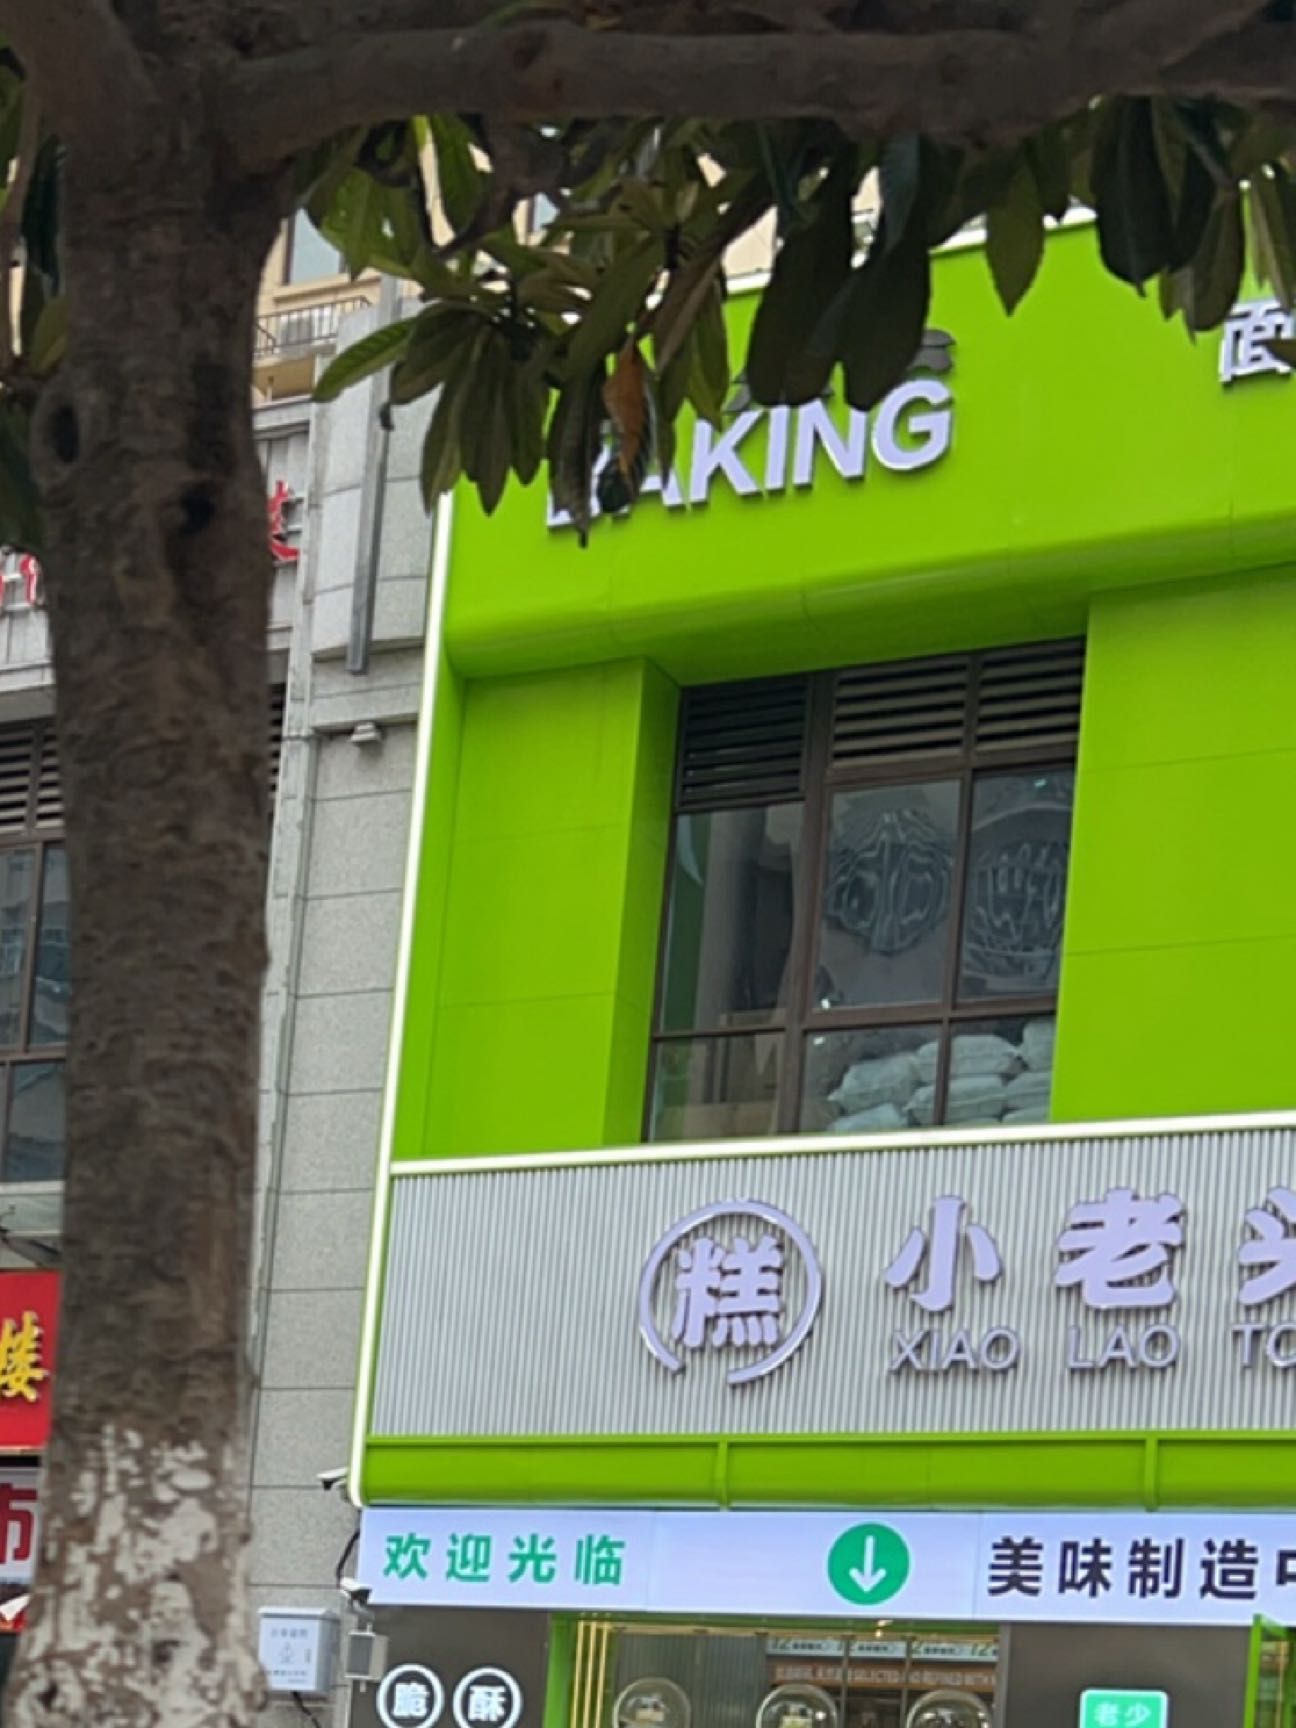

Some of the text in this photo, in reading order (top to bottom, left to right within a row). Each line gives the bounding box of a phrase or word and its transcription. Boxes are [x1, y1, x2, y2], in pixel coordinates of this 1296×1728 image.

[547, 377, 955, 527] KING
[671, 1236, 785, 1350] 糕
[888, 1324, 1021, 1373] XIAO
[1066, 1323, 1181, 1369] LAO
[382, 1533, 627, 1588] 欢迎光临
[1094, 1702, 1152, 1728] 老少
